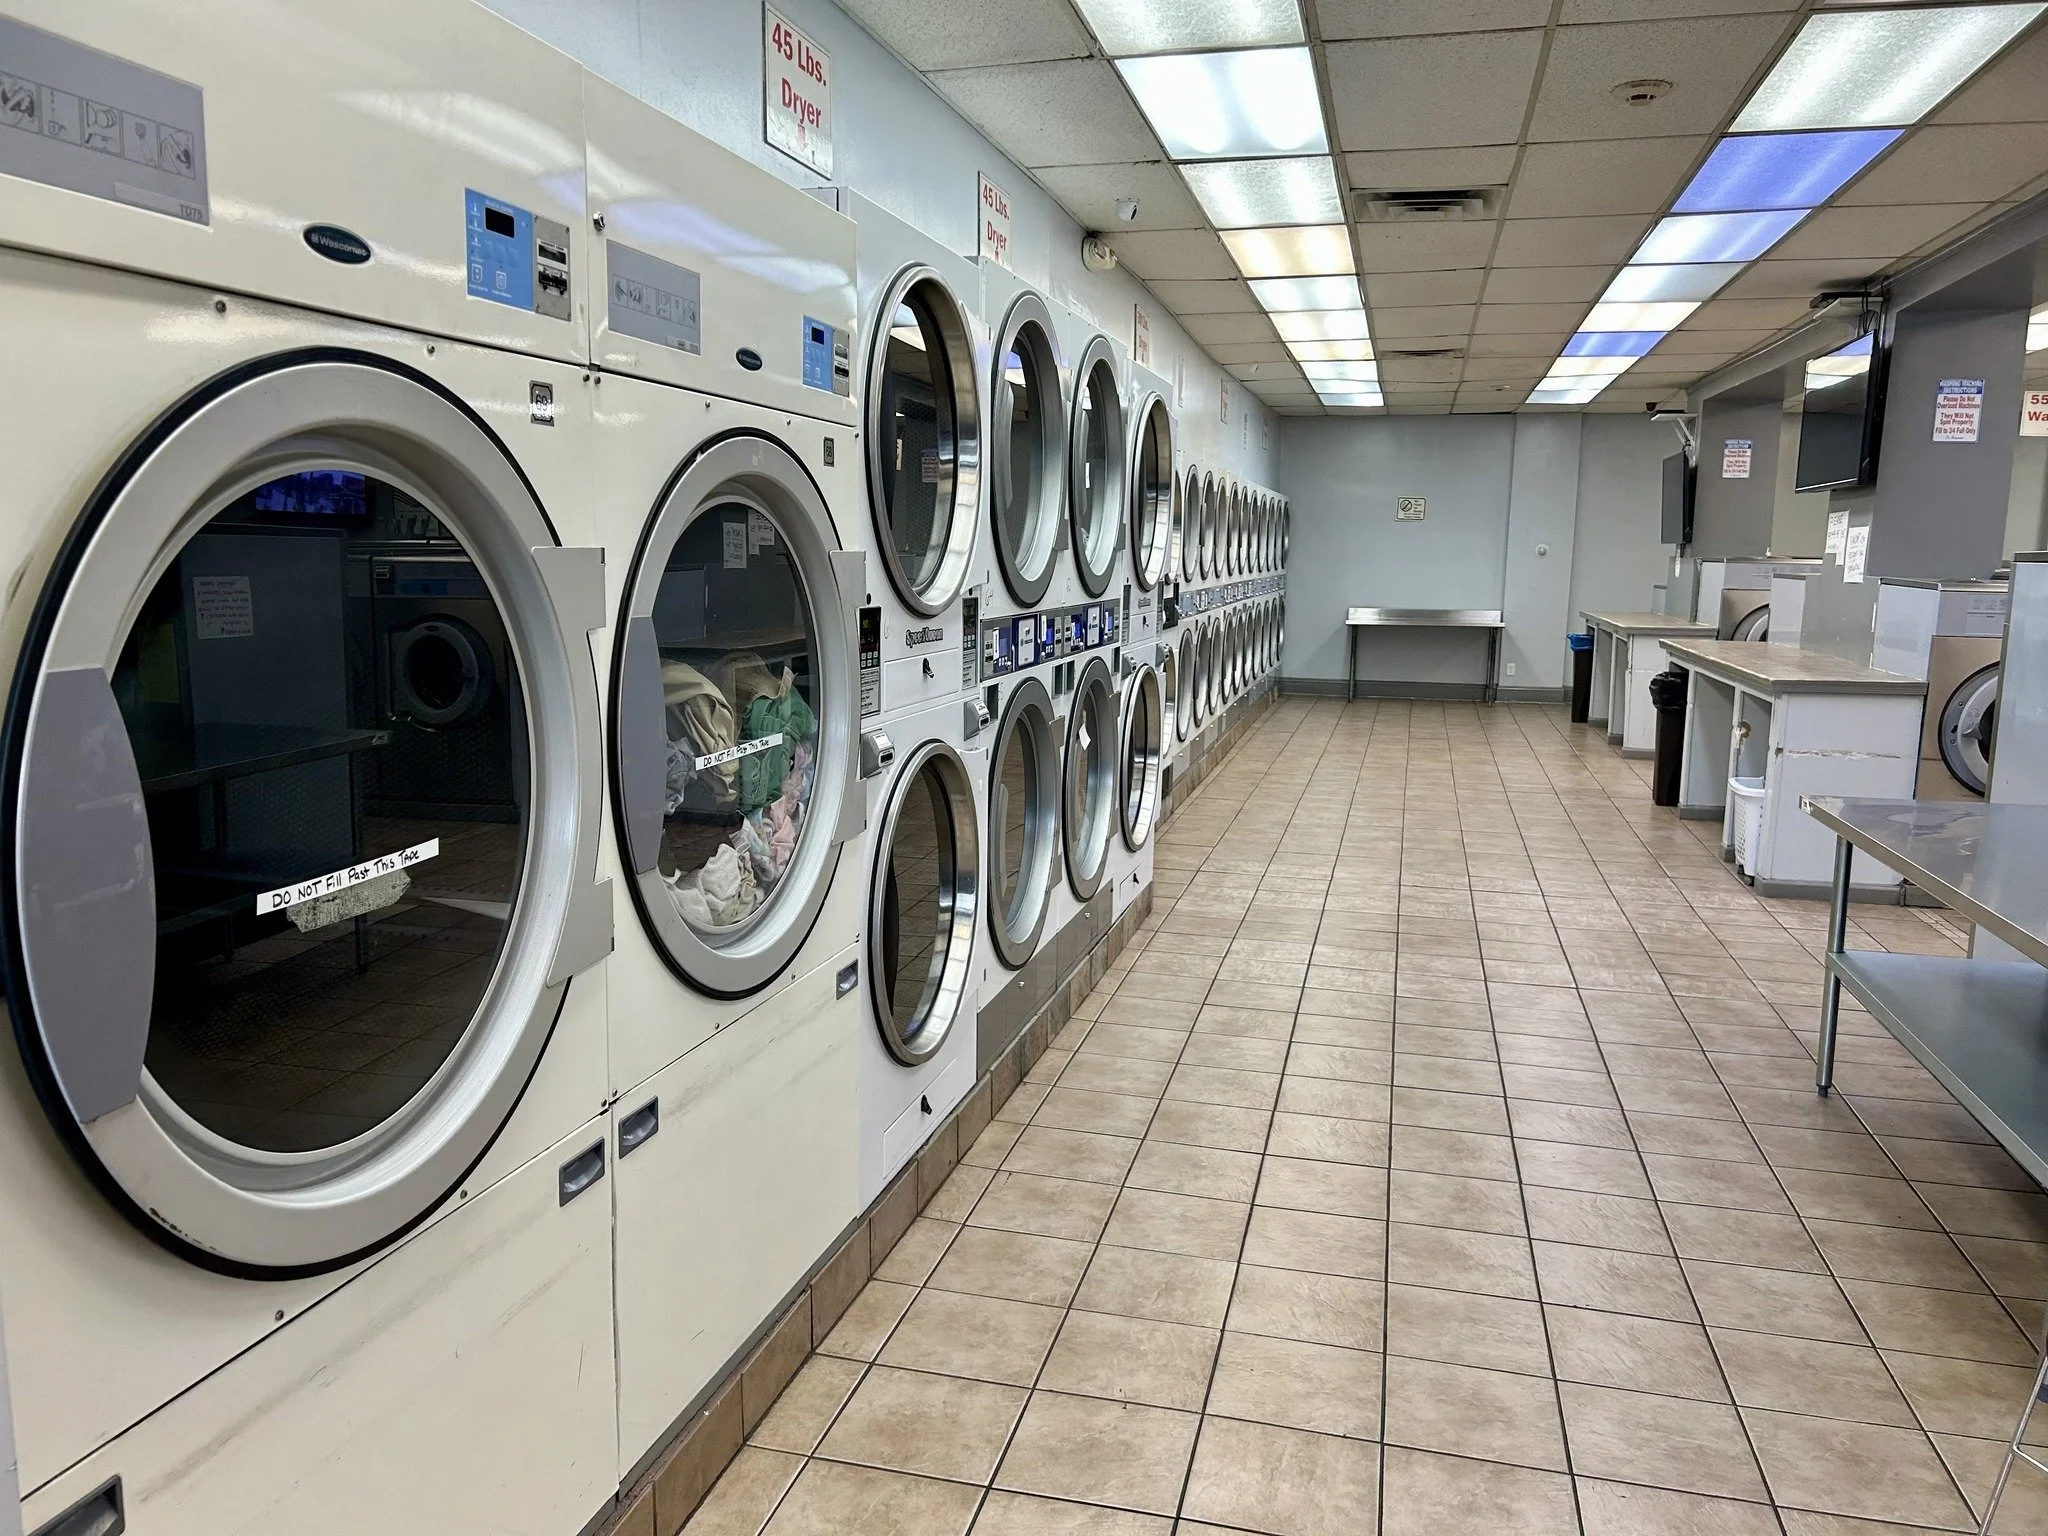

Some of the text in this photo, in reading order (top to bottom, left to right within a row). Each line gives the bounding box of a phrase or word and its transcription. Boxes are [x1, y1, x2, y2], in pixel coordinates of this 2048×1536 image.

[772, 22, 827, 87] 45 Lbs.
[781, 77, 822, 129] Dryer
[983, 183, 1010, 221] 45 Lbs.
[987, 220, 1007, 251] Dryer
[2030, 394, 2048, 405] 55
[703, 756, 712, 768] DO
[272, 890, 292, 909] DO
[298, 879, 323, 900] NOT
[326, 874, 342, 892] Fill
[347, 866, 371, 884] Past
[373, 858, 395, 875] This
